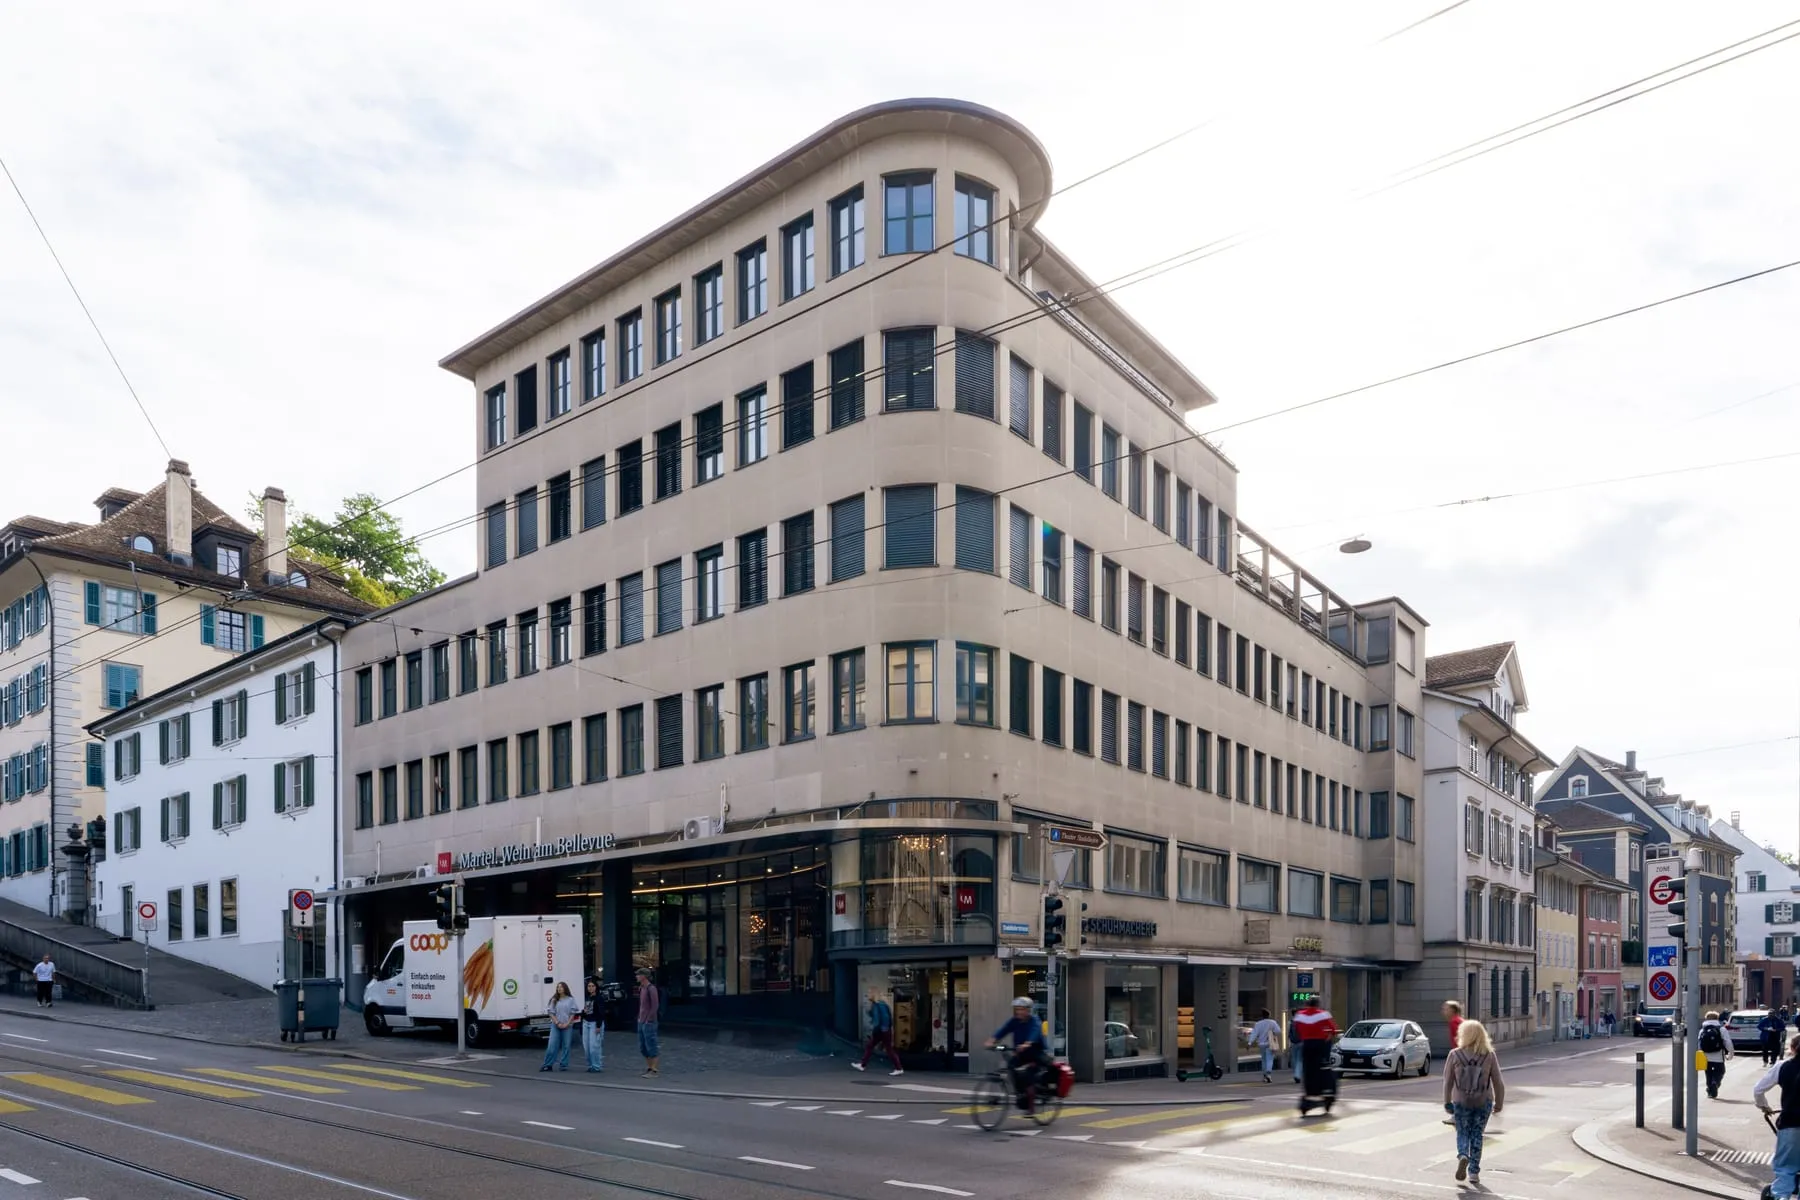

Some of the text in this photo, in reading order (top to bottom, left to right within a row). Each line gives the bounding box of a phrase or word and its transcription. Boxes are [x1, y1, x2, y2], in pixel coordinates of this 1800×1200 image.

[460, 832, 616, 869] Martel. Wein am Bellevue.
[410, 933, 449, 955] coop
[545, 929, 554, 972] coop.ch
[410, 972, 429, 980] Einfach
[1293, 993, 1312, 1001] FRE
